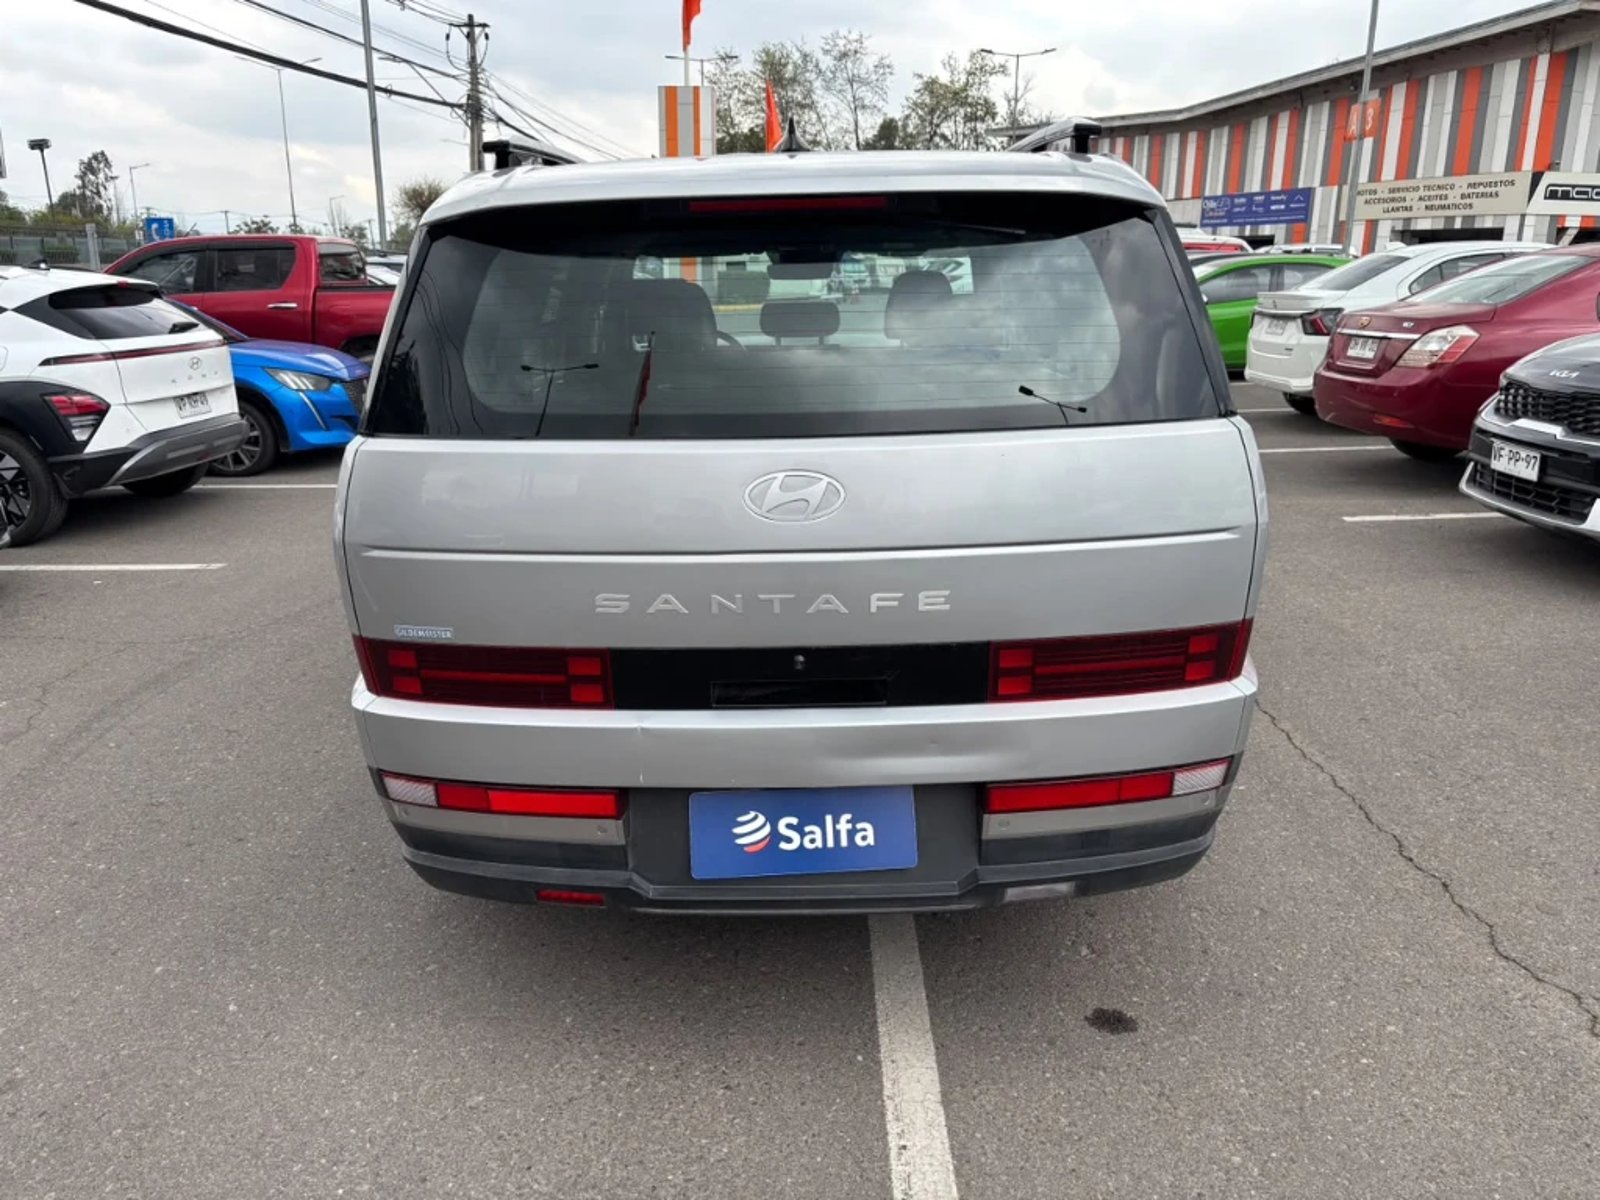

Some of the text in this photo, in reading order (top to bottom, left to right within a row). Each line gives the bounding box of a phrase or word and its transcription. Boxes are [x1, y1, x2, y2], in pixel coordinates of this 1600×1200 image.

[1388, 184, 1420, 194] SERVICIO
[1423, 183, 1455, 192] TECNICO
[1467, 179, 1516, 190] REPUESTOS
[1417, 193, 1449, 202] ACEITES
[1460, 191, 1499, 200] BATERIAS
[1383, 203, 1474, 214] LLANTAS NEUMATICOS
[777, 812, 875, 851] Salfa
